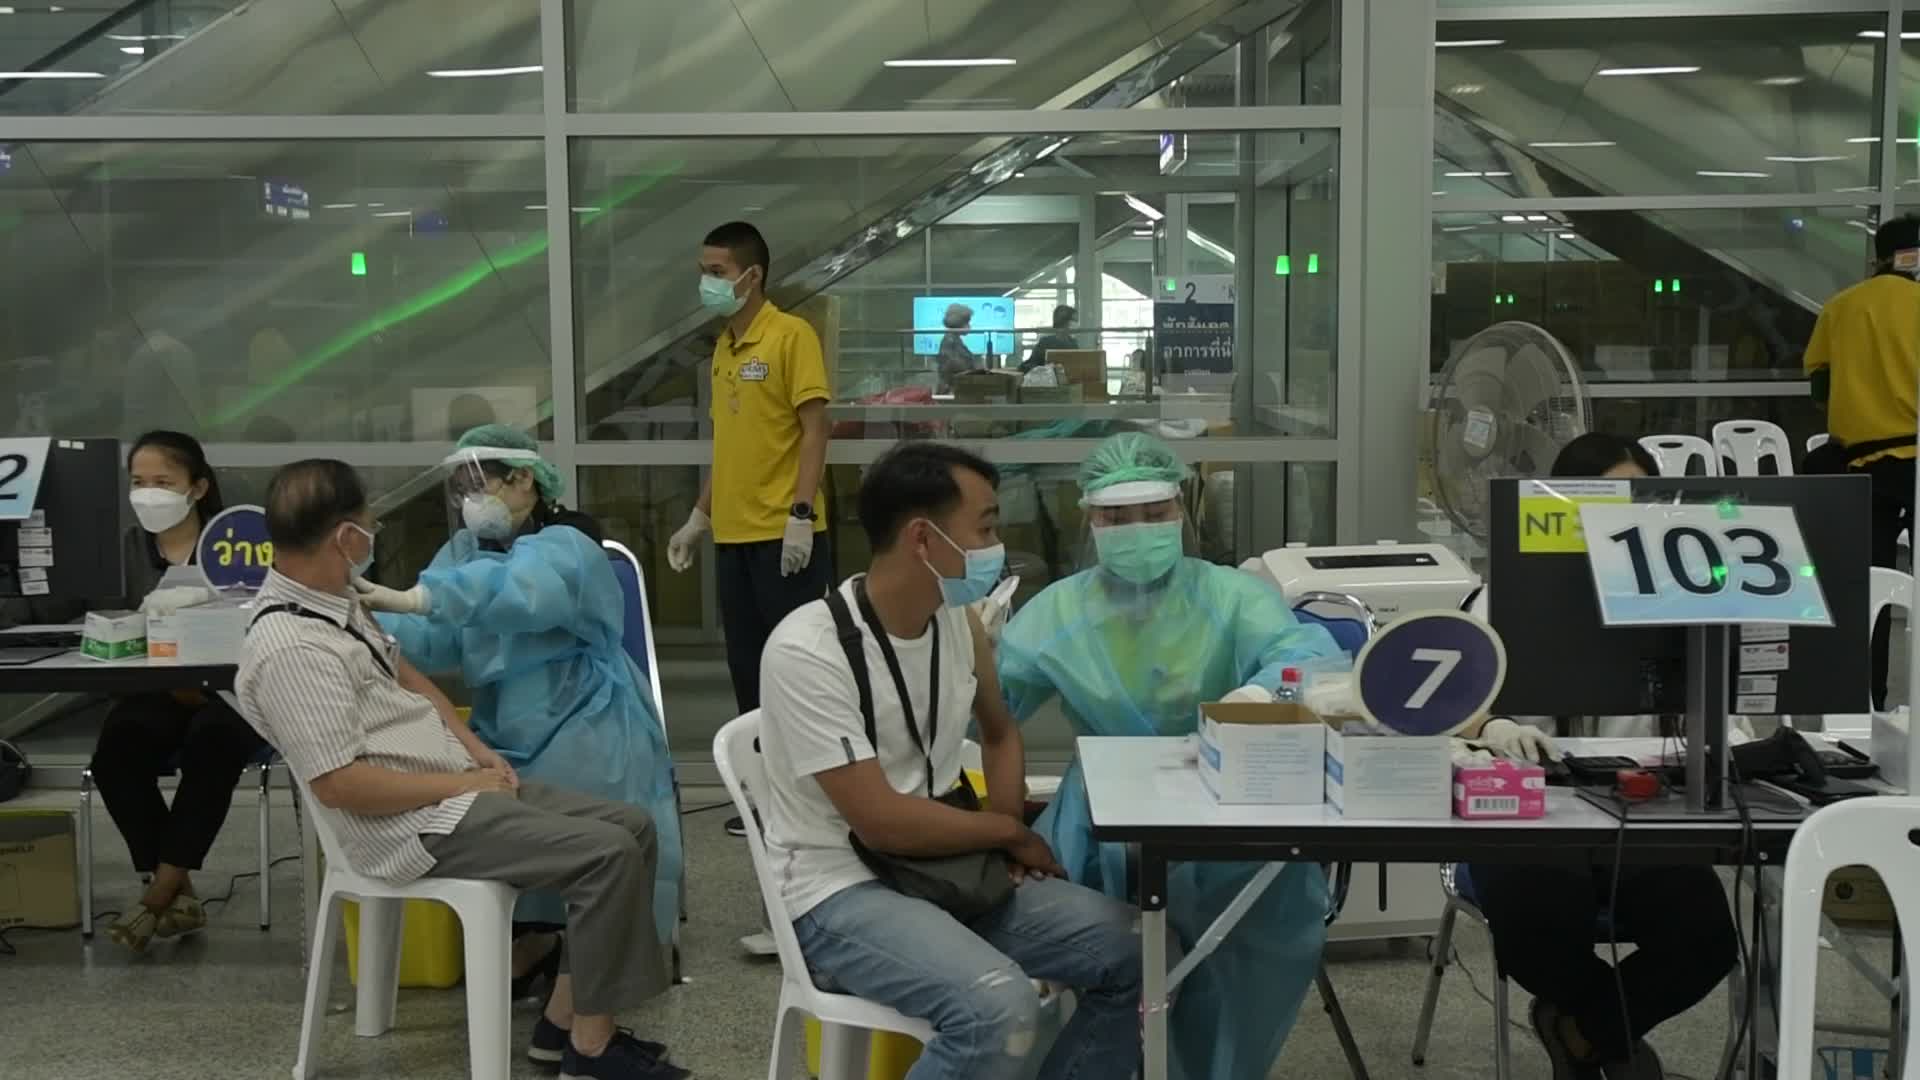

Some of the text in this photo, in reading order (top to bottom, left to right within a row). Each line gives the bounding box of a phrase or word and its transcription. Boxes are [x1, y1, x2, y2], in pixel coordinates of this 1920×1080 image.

[213, 528, 273, 566] ว่าง
[1609, 526, 1791, 596] 103
[1404, 648, 1462, 709] 7
